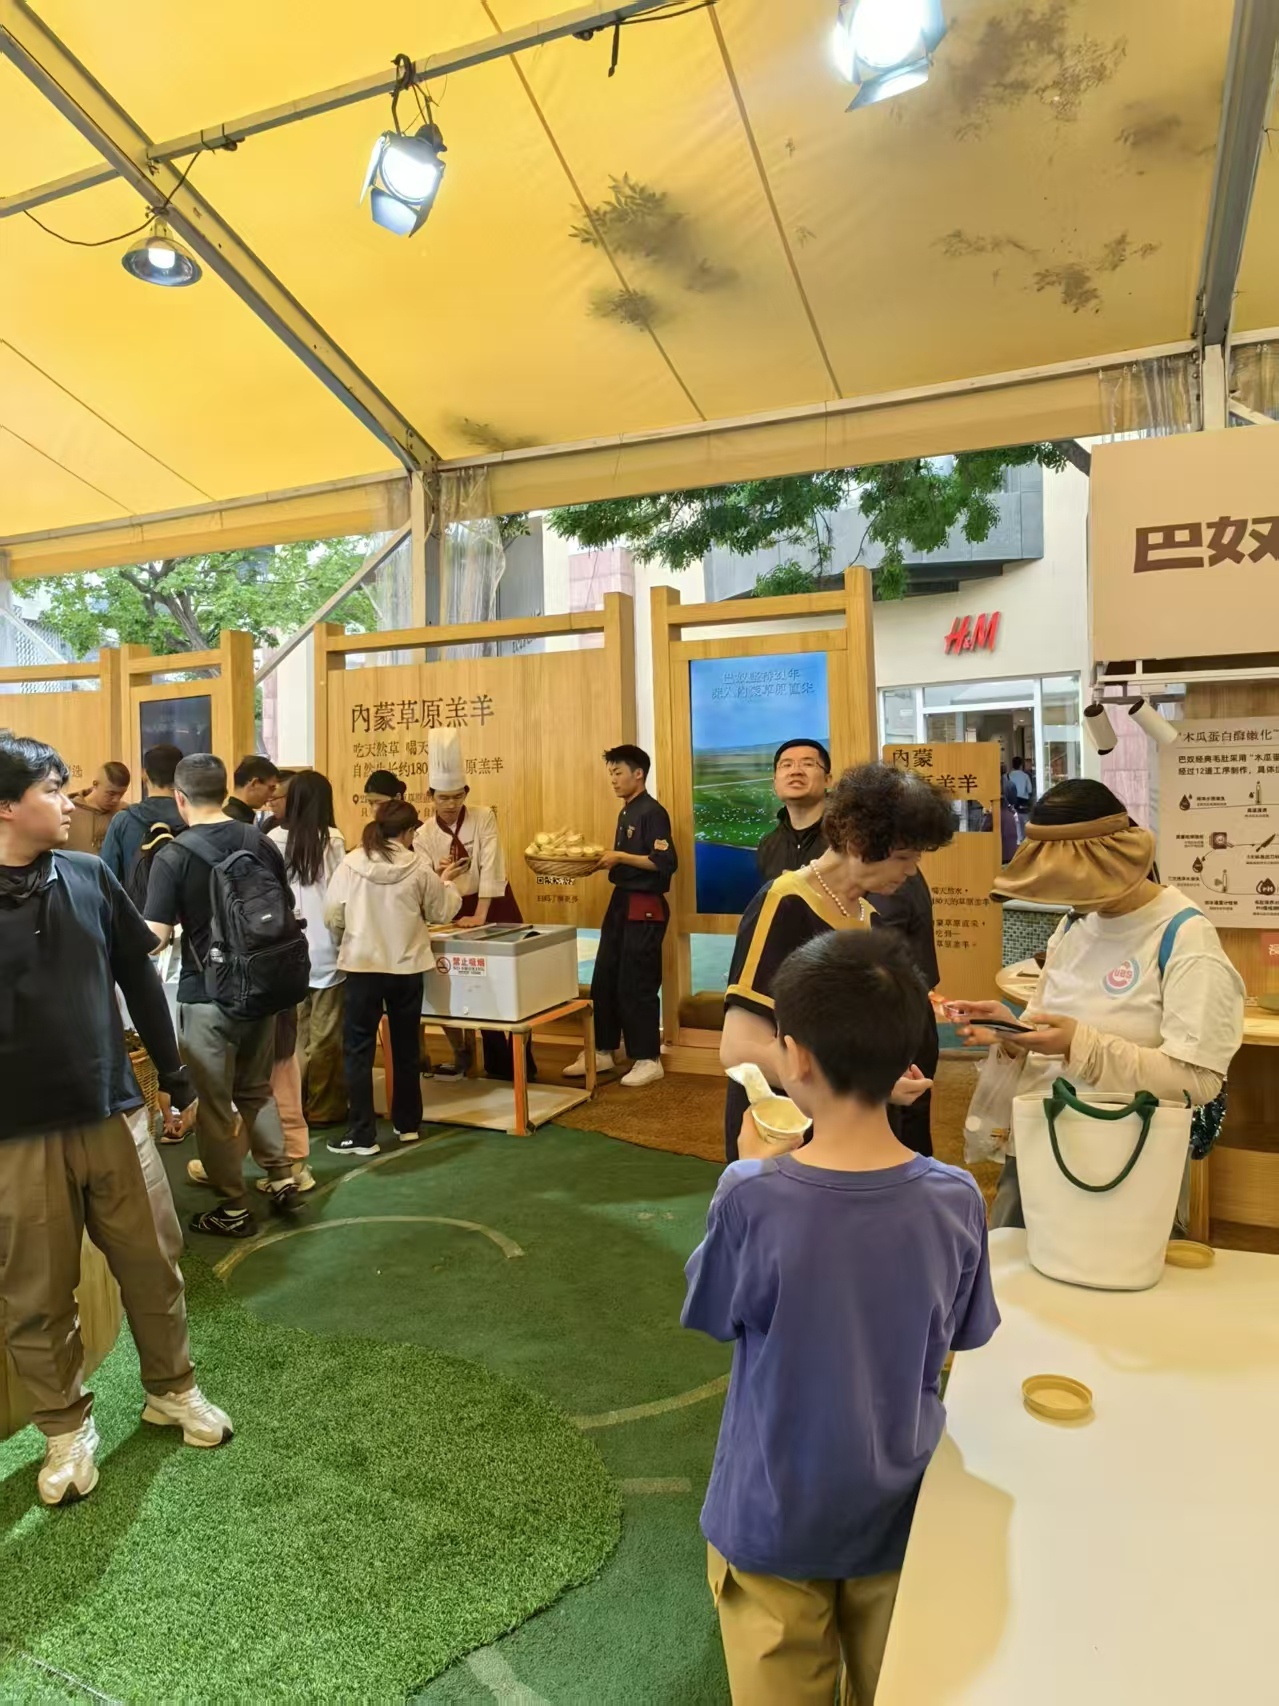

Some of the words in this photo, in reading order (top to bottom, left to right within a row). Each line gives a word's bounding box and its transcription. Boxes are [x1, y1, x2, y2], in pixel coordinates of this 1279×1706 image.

[1133, 516, 1279, 573] 巴奴
[944, 611, 1000, 656] H&M
[353, 741, 400, 758] 吃天然草
[465, 756, 504, 775] 原羔羊
